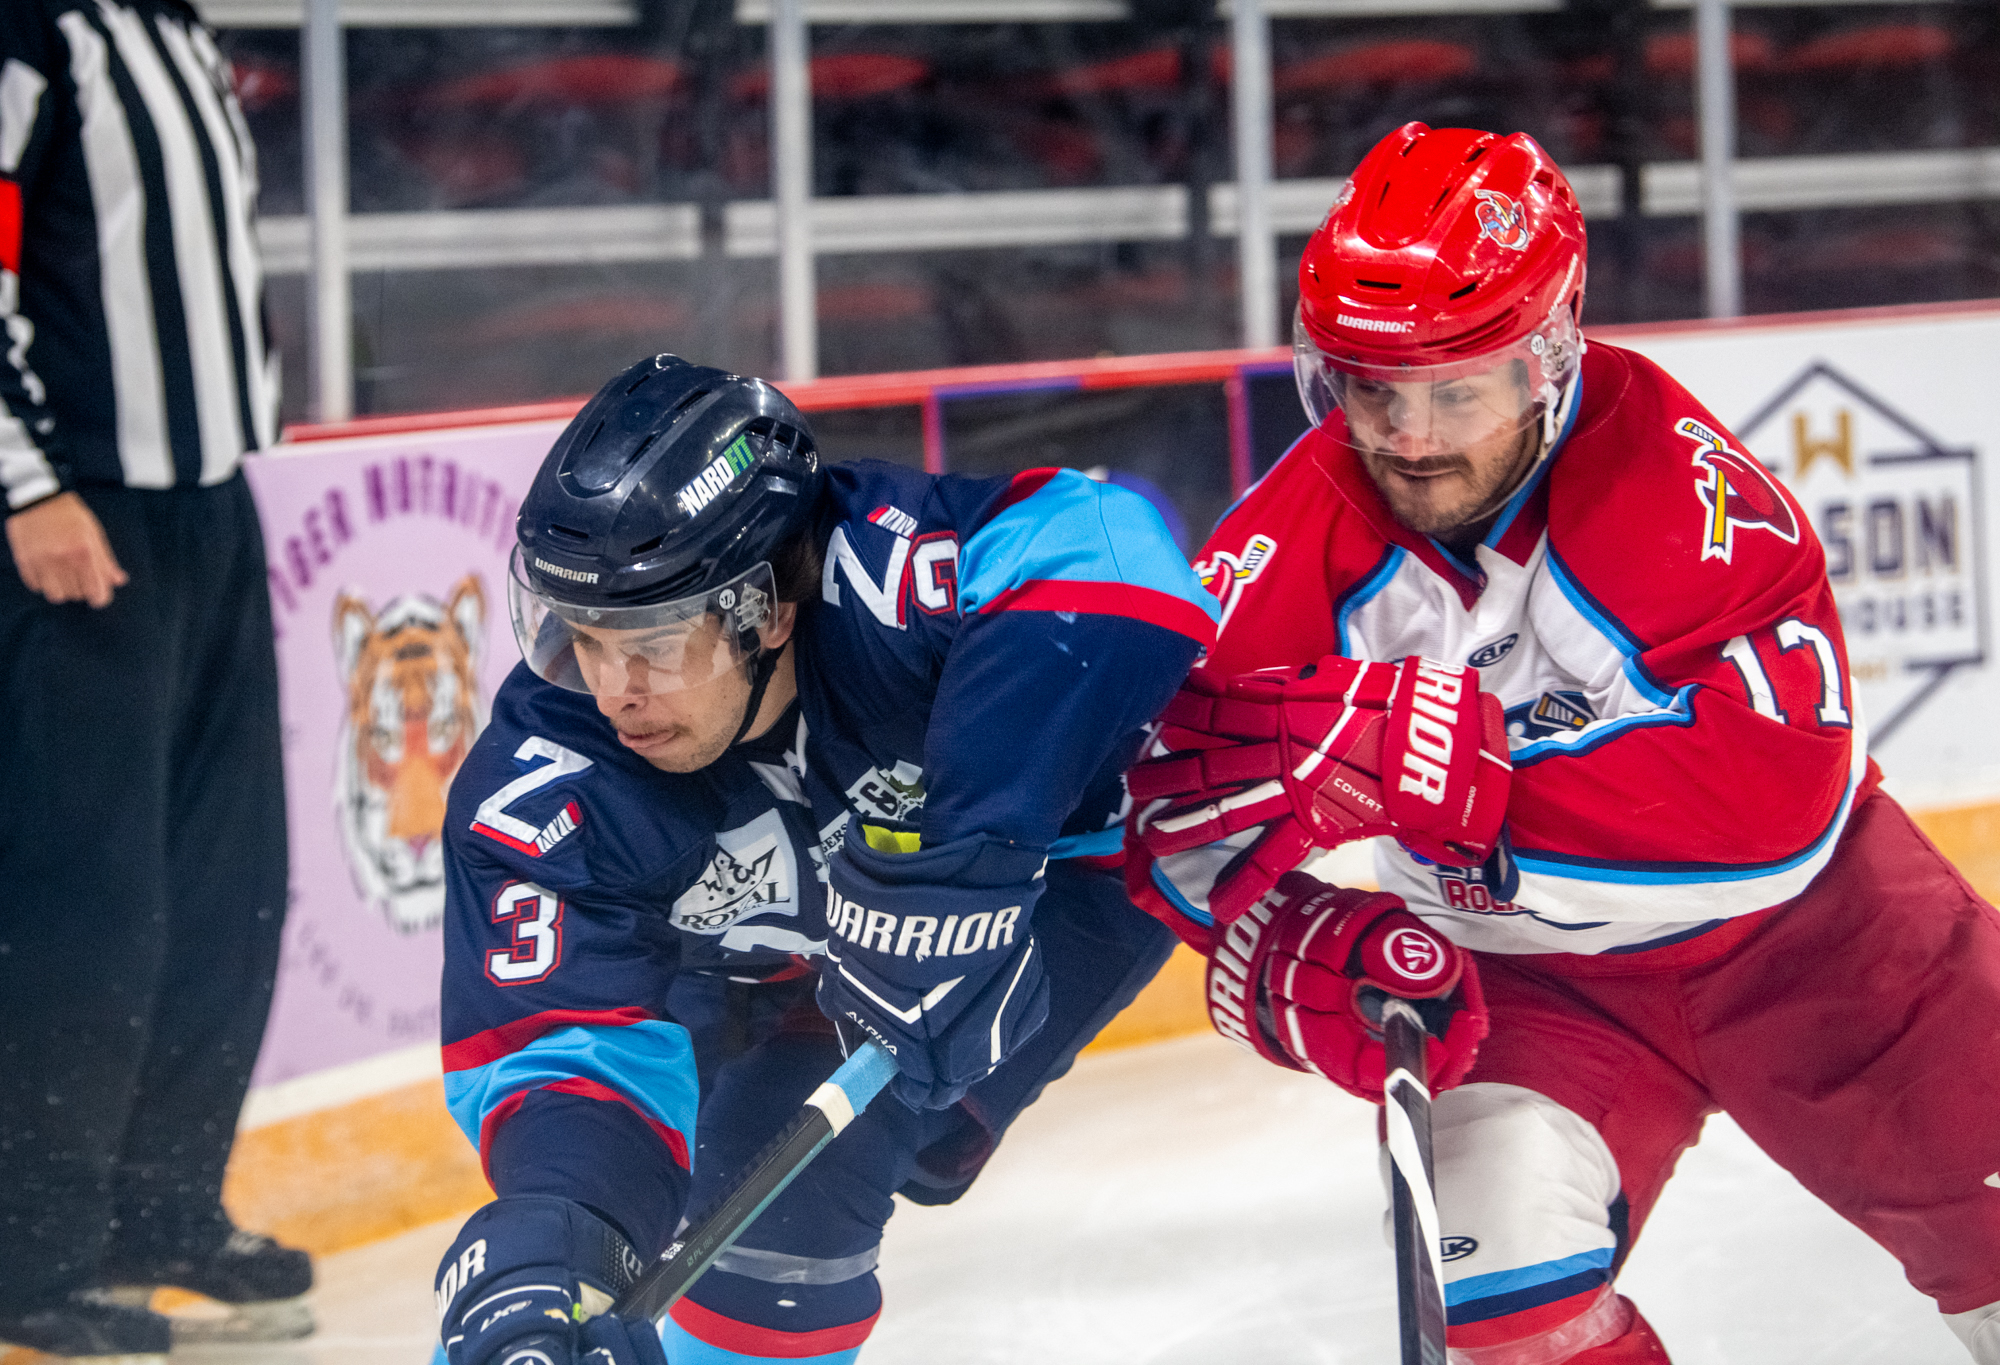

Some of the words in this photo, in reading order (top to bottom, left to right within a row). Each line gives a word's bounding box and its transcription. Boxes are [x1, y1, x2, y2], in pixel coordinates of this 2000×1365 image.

[1336, 313, 1415, 333] WARRIOR
[535, 557, 599, 585] WARRIOR
[1720, 616, 1853, 729] 17
[1333, 777, 1384, 812] COVERT
[484, 879, 565, 988] 3
[845, 1011, 898, 1057] ALPHA
